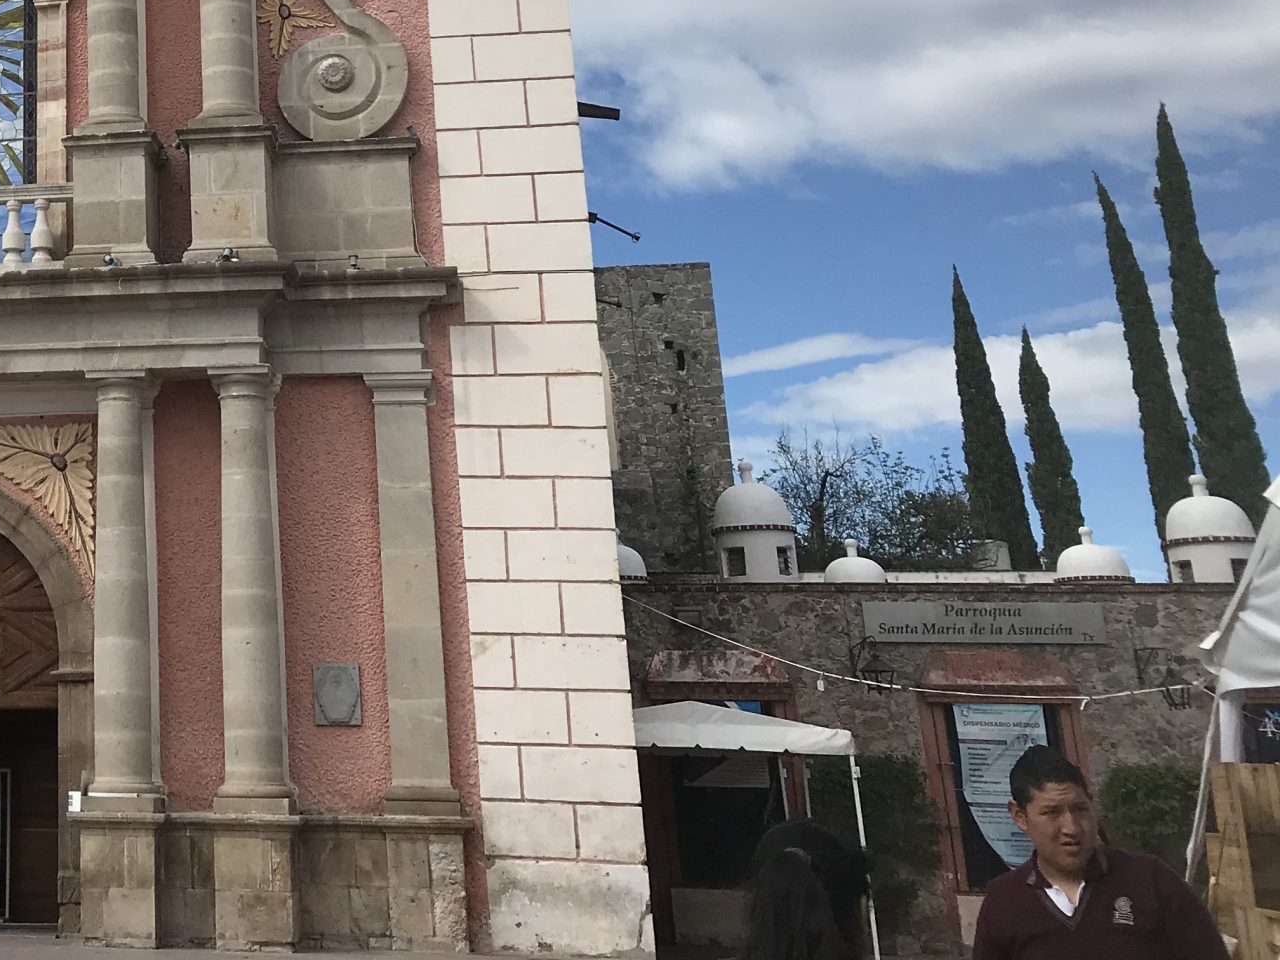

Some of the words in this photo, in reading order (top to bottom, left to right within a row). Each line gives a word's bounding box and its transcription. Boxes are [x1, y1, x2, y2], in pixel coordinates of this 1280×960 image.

[943, 603, 1022, 621] Parroquia
[878, 622, 919, 635] Santa
[921, 622, 965, 635] María
[969, 623, 986, 635] de
[990, 623, 1003, 635] la
[1006, 623, 1073, 636] Asunción
[963, 720, 1011, 728] DISPENSARIO
